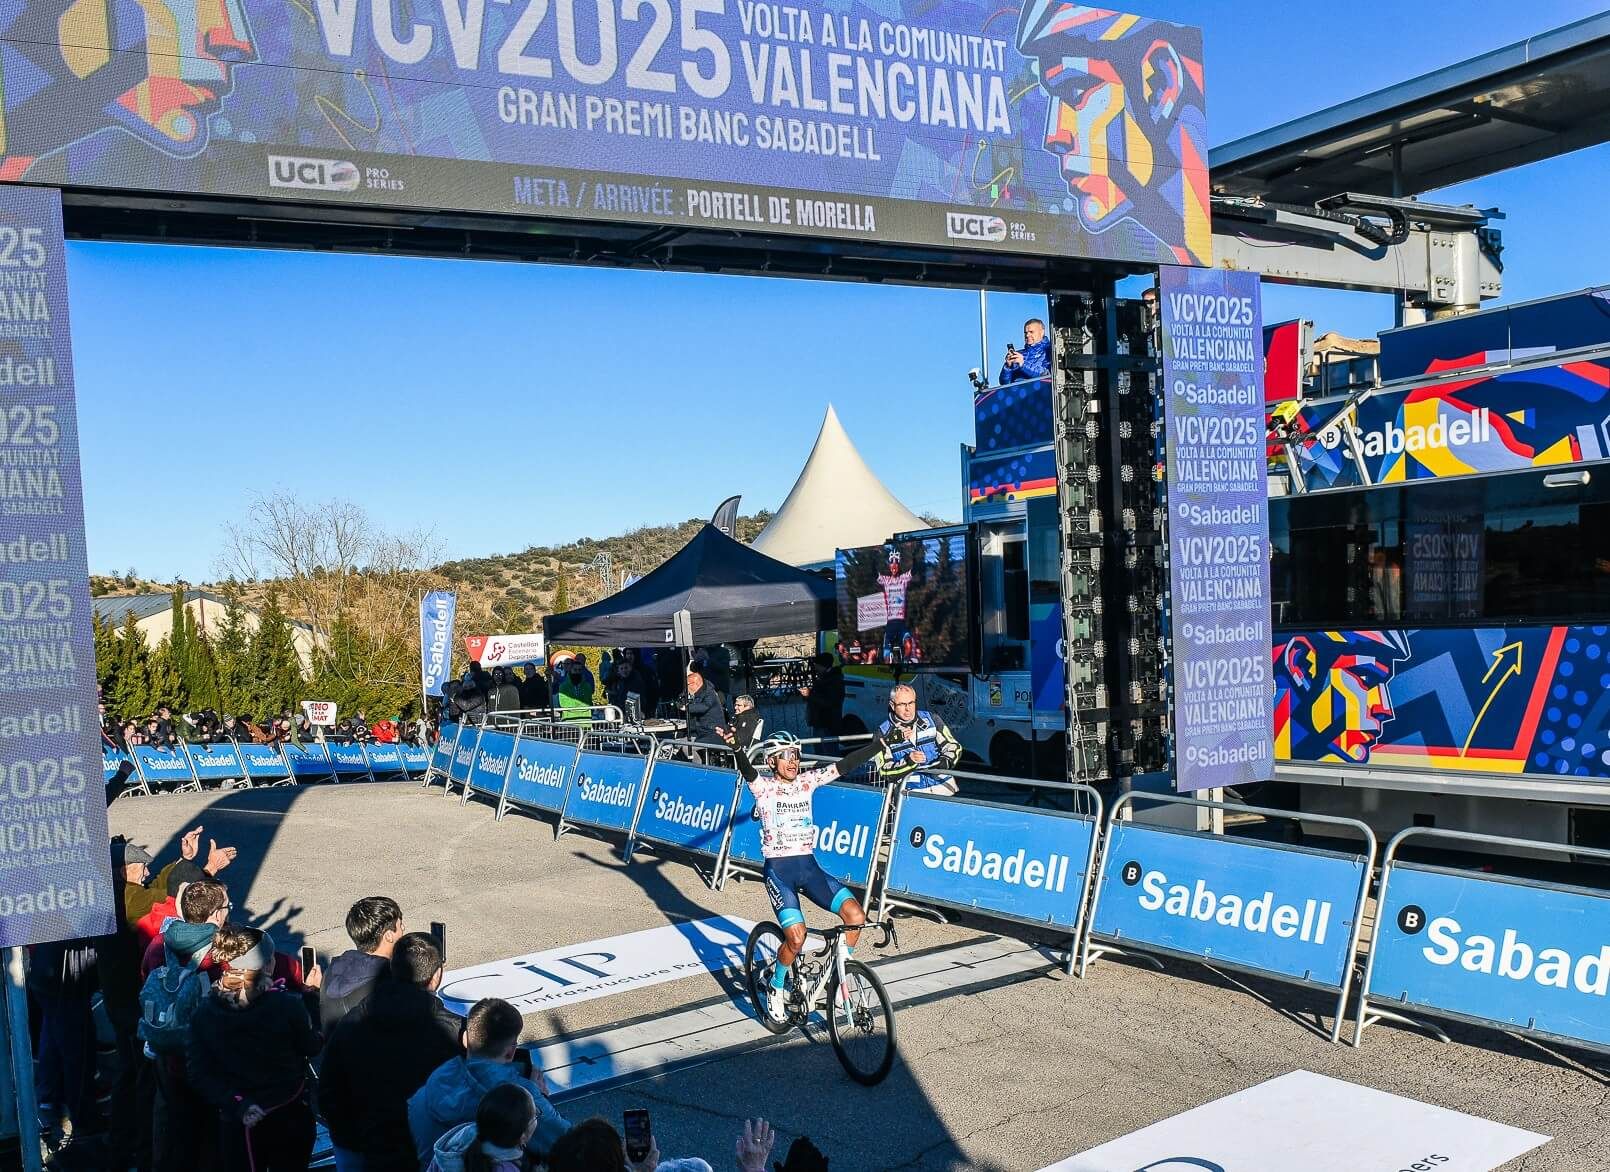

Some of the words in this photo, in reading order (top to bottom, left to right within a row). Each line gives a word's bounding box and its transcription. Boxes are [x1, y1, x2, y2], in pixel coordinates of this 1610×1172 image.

[738, 0, 814, 44] VOLTA
[821, 13, 837, 48] A
[842, 15, 874, 53] LA
[878, 21, 1007, 72] COMUNITAT
[317, 0, 731, 98] VCV2025
[740, 40, 1012, 135] VALENCIANA
[498, 87, 577, 130] GRAN
[586, 97, 673, 140] PREMI
[679, 106, 749, 147] BANC
[756, 115, 882, 161] SABADELL
[274, 161, 326, 185] UCI
[366, 167, 389, 179] PRO
[366, 179, 404, 191] SERIES
[513, 177, 568, 207] META
[687, 189, 764, 222] PORTELL
[769, 196, 791, 225] DE
[796, 198, 876, 231] MORELLA
[951, 217, 985, 236] UCI
[1010, 222, 1026, 231] PRO
[1010, 231, 1036, 241] SERIES
[1170, 293, 1252, 325] VCV2025
[1171, 324, 1193, 336] VOLTA
[1196, 325, 1200, 337] A
[1202, 326, 1211, 337] LA
[1212, 326, 1253, 340] COMUNITAT
[1172, 337, 1255, 361] VALENCIANA
[1173, 361, 1189, 370] GRAN
[1190, 361, 1208, 371] PREMI
[1209, 361, 1224, 372] BANC
[1225, 362, 1255, 373] SABADELL
[1186, 383, 1256, 405] Sabadell
[1175, 416, 1258, 445] VCV2025
[1326, 431, 1335, 443] B
[1342, 407, 1490, 460] Sabadell
[1176, 447, 1198, 458] VOLTA
[1200, 447, 1205, 458] A
[1206, 447, 1216, 458] LA
[1216, 447, 1258, 459] COMUNITAT
[1176, 460, 1259, 481] VALENCIANA
[1177, 483, 1193, 492] GRAN
[1194, 483, 1212, 492] PREMI
[1213, 483, 1228, 492] BANC
[1230, 482, 1258, 492] SABADELL
[1190, 504, 1260, 525] Sabadell
[1179, 535, 1261, 565] VCV2025
[1180, 567, 1202, 579] VOLTA
[1204, 566, 1209, 579] A
[1210, 566, 1219, 579] LA
[1221, 564, 1261, 578] COMUNITAT
[1180, 577, 1262, 601] VALENCIANA
[428, 600, 448, 677] Sabadell
[1194, 621, 1263, 645] Sabadell
[1184, 655, 1264, 689] VCV2025
[1184, 690, 1206, 703] VOLTA
[1214, 688, 1223, 701] LA
[1224, 685, 1264, 699] COMUNITAT
[315, 703, 328, 711] NO
[1184, 697, 1265, 726] VALENCIANA
[147, 756, 186, 770] Sabadell
[198, 753, 237, 768] Sabadell
[250, 754, 284, 767] Sabadell
[479, 750, 508, 776] Sabadell
[1198, 740, 1266, 767] Sabadell
[519, 758, 566, 788] Sabadell
[581, 776, 636, 808] Sabadell
[656, 792, 725, 832] Sabadell
[923, 833, 1069, 893] Sabadell
[1138, 871, 1332, 945] Sabadell
[1423, 917, 1610, 997] Sabad
[523, 967, 671, 1006] Infrastructure
[1399, 1154, 1449, 1172] ers
